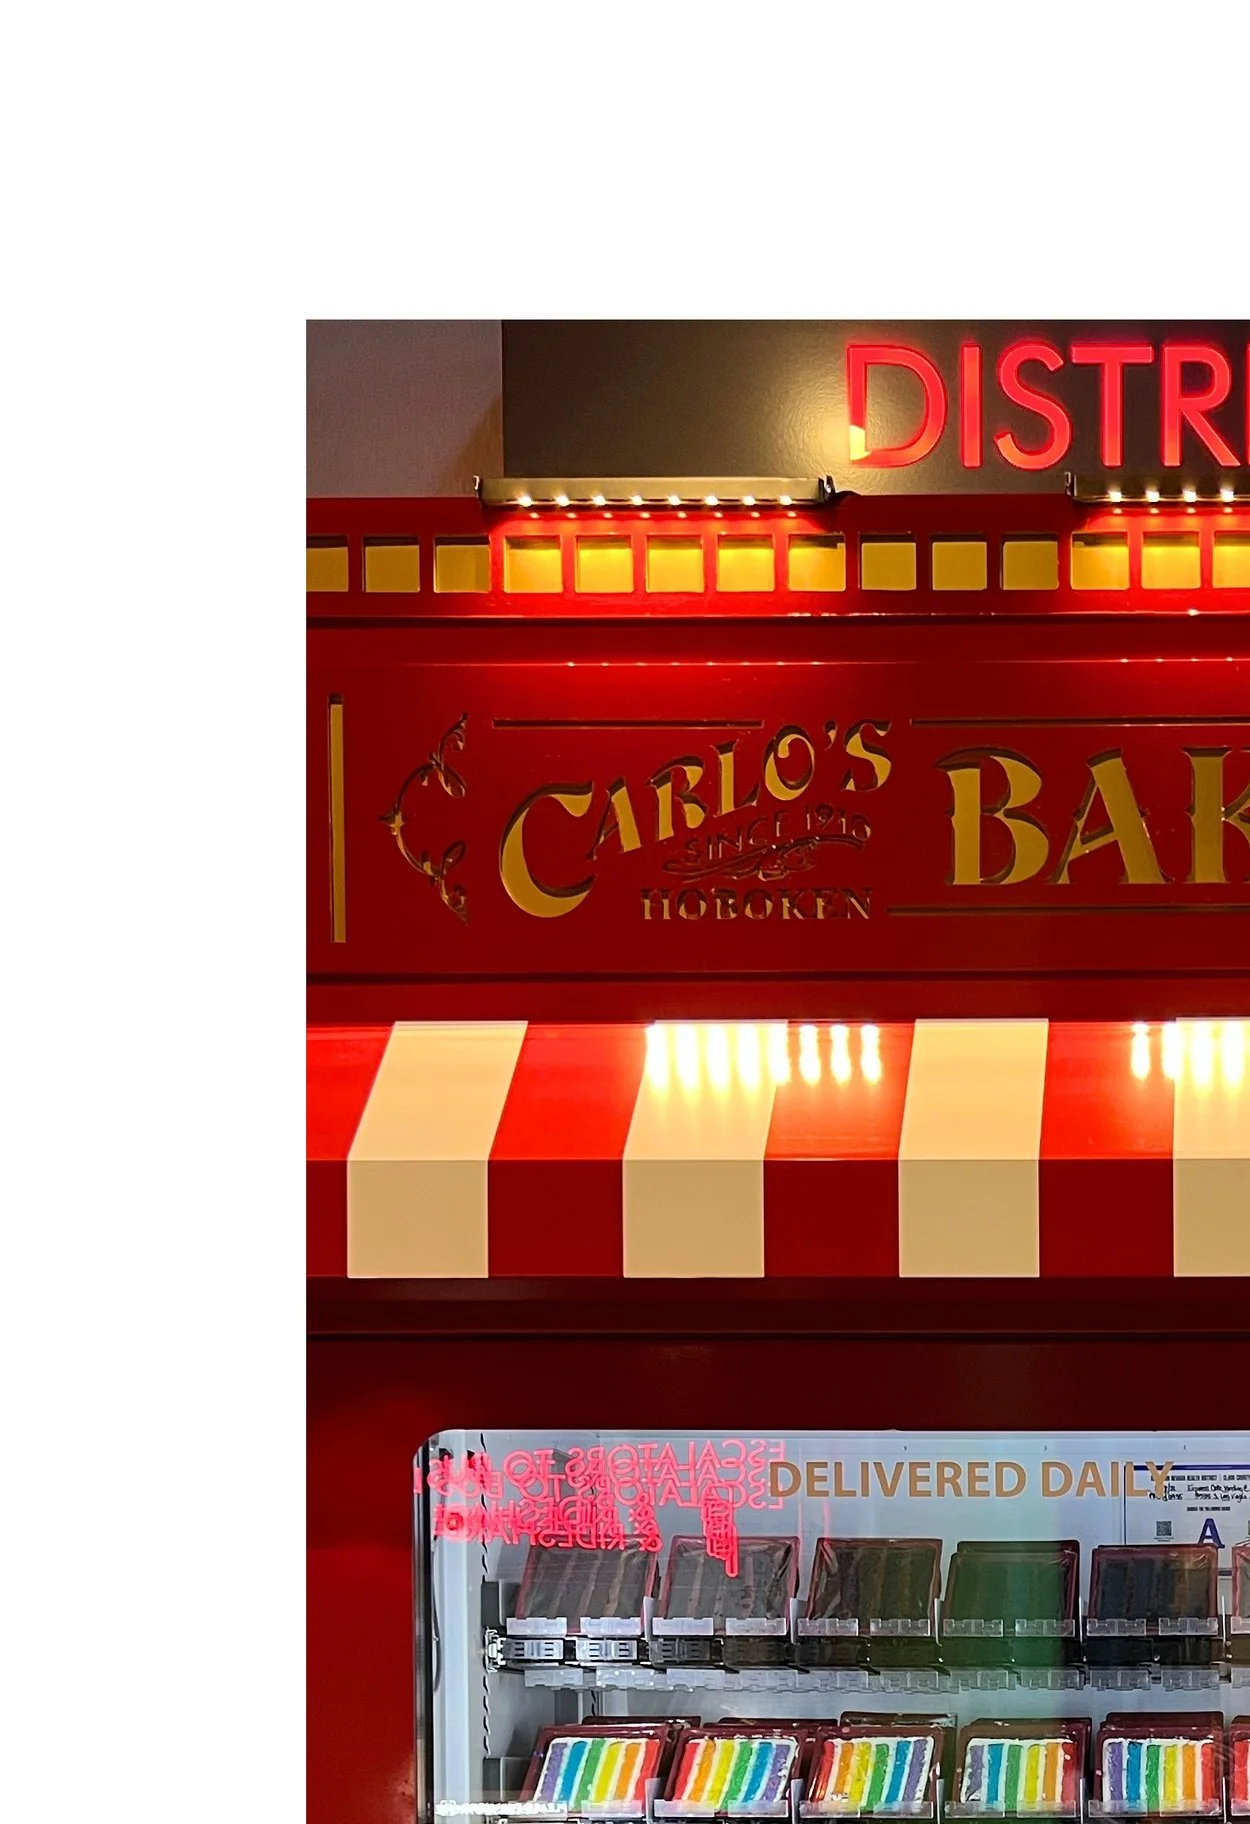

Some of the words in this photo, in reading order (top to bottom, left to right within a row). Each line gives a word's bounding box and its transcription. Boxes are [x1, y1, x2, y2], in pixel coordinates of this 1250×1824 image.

[499, 718, 893, 918] CARLO'S
[684, 808, 788, 866] SINCE
[803, 803, 873, 842] 1910
[640, 886, 875, 920] HOBOKEN
[769, 1461, 1027, 1498] DELIVERED
[1042, 1461, 1174, 1498] DAILY
[1198, 1518, 1225, 1549] A
